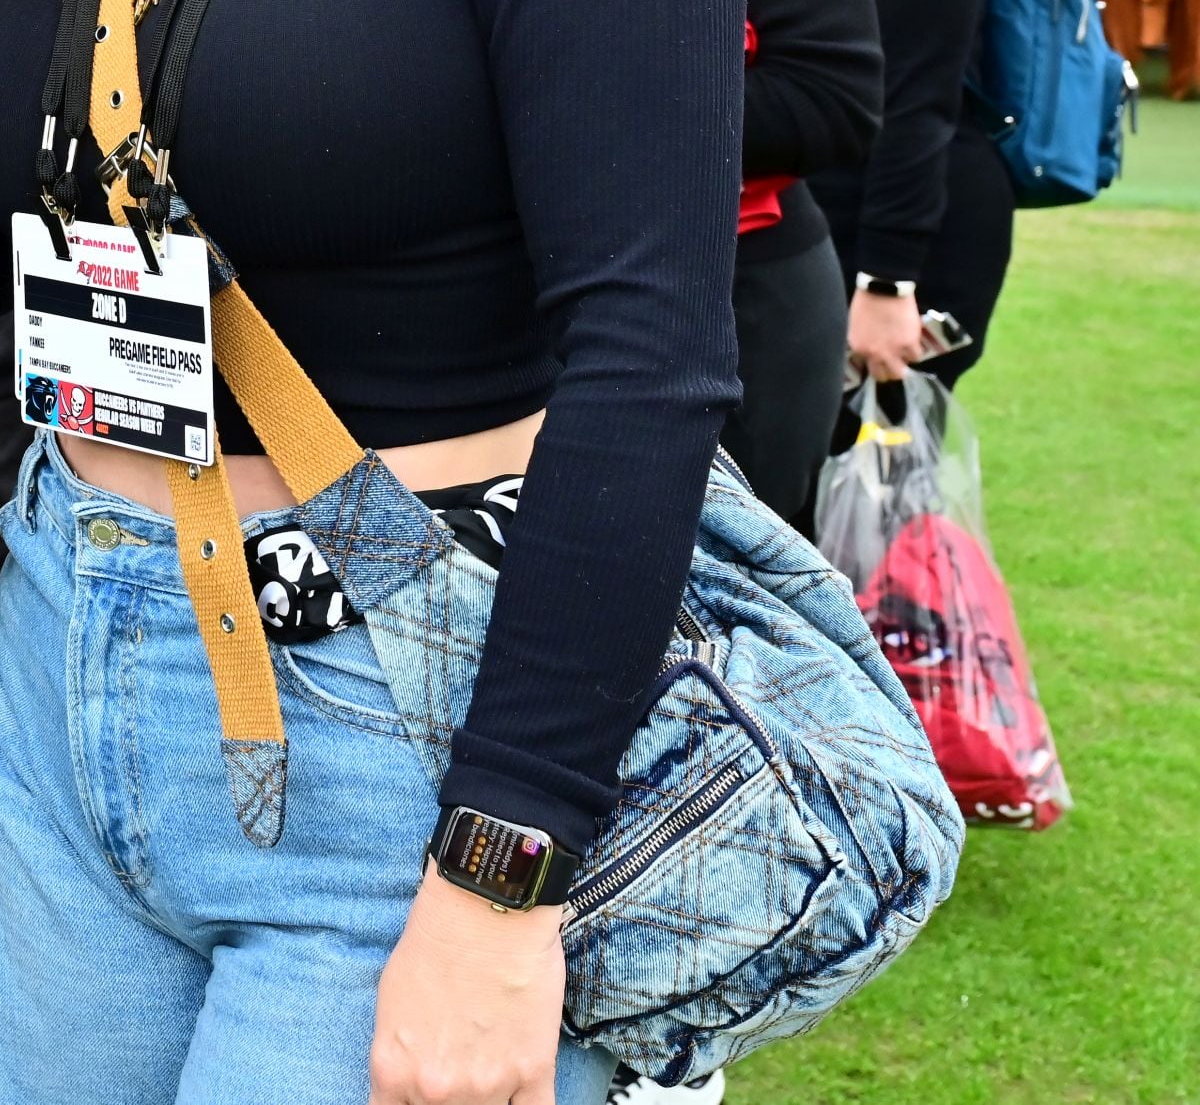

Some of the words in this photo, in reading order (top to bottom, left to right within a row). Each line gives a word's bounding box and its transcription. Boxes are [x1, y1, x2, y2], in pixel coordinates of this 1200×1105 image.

[92, 264, 112, 287] 2022
[114, 268, 139, 291] GAME
[91, 292, 118, 323] ZONE
[118, 297, 127, 324] D
[109, 336, 150, 365] PREGAME
[152, 345, 177, 370] FIELD
[178, 351, 202, 375] PASS
[459, 823, 480, 869] bendiciones
[479, 844, 494, 870] Happy
[492, 855, 501, 863] to
[474, 869, 484, 885] new
[486, 863, 497, 881] your
